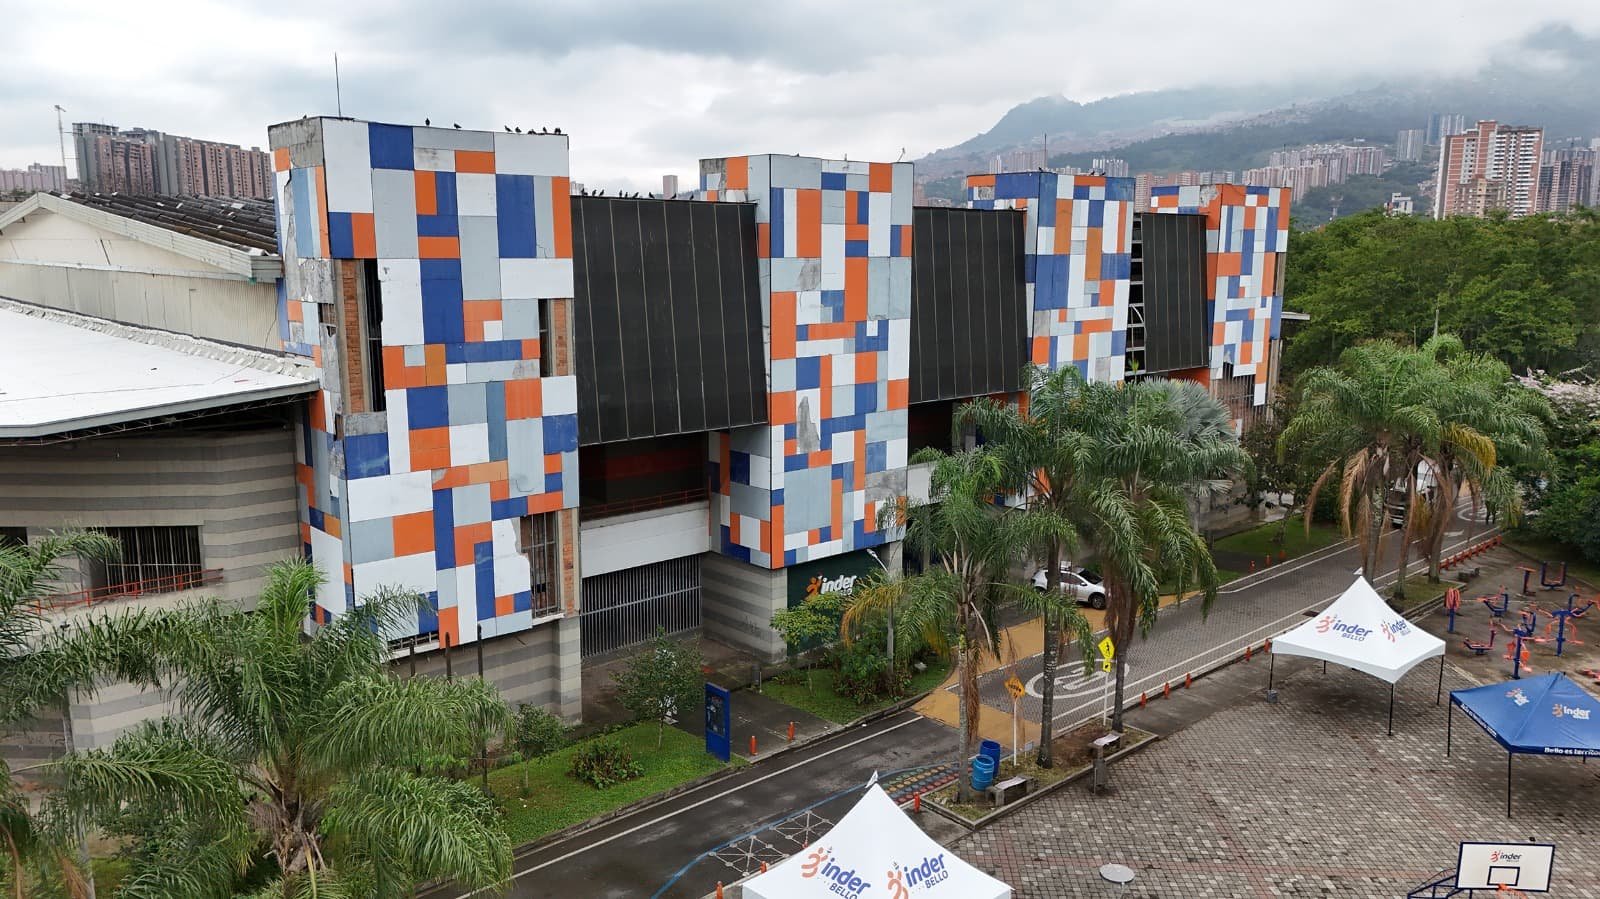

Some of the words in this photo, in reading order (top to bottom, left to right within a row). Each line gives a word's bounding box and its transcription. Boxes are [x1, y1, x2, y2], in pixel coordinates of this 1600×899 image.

[821, 575, 857, 594] inder
[1333, 620, 1373, 637] inder
[1341, 632, 1365, 641] BELLO
[1500, 852, 1522, 860] inder
[821, 857, 871, 895] inder
[904, 853, 944, 887] inder
[925, 870, 949, 889] BELLO
[829, 882, 858, 899] BELLO
